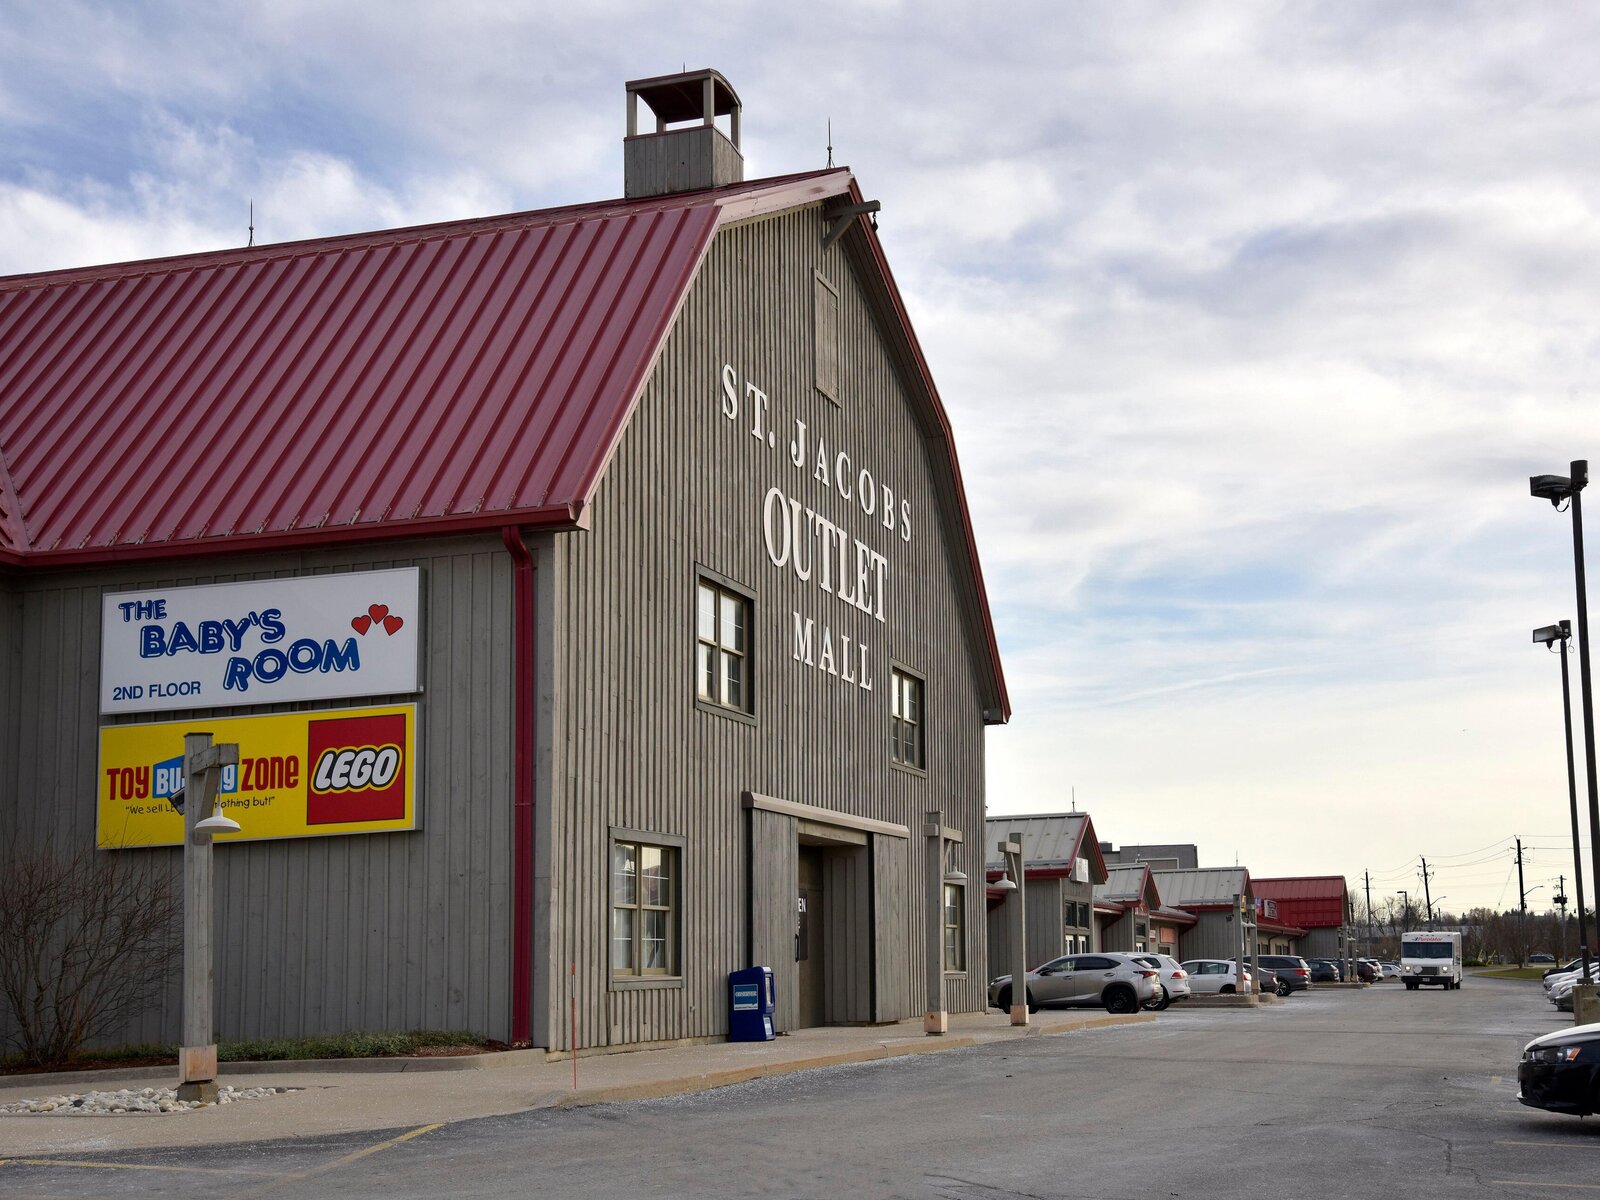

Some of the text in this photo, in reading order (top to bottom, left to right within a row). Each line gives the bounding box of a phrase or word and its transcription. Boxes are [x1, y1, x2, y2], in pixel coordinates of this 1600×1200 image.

[722, 364, 911, 542] ST. JACOBS
[763, 487, 888, 623] OUTLET
[118, 599, 167, 622] THE
[140, 608, 286, 658] BABY'S
[223, 637, 360, 691] ROOM
[793, 611, 872, 691] MALL
[113, 681, 201, 701] 2ND FLOOR
[313, 746, 400, 791] LEGO
[146, 804, 162, 813] sell
